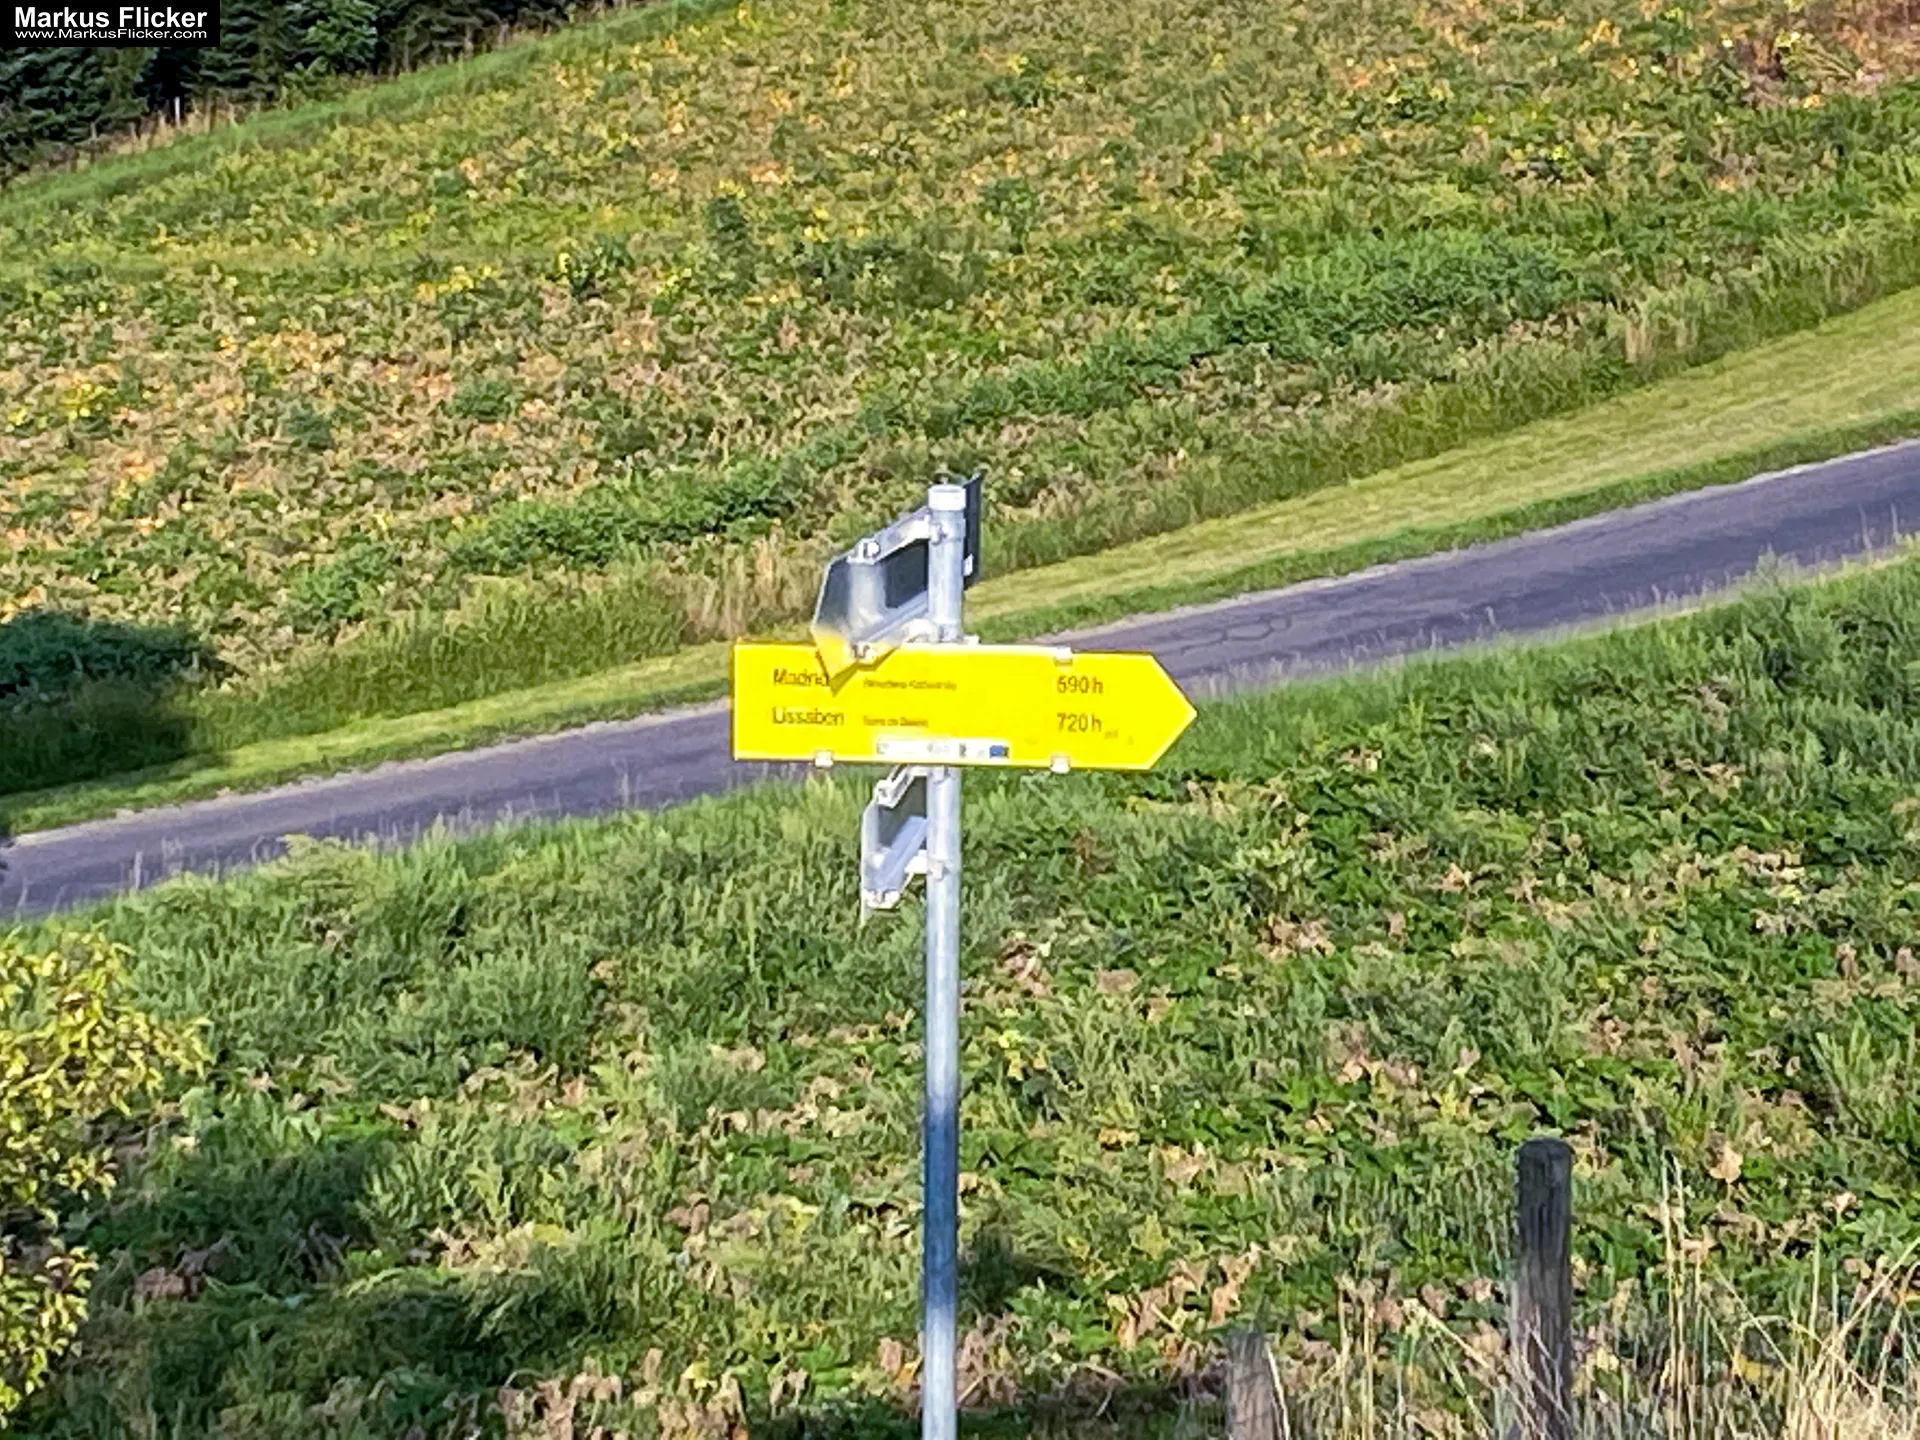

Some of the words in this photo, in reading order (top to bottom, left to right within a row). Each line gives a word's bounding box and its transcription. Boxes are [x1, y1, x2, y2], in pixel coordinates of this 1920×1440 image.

[1057, 675, 1088, 693] 590
[1091, 676, 1103, 694] h
[1056, 712, 1087, 732] 720
[1090, 713, 1102, 732] h
